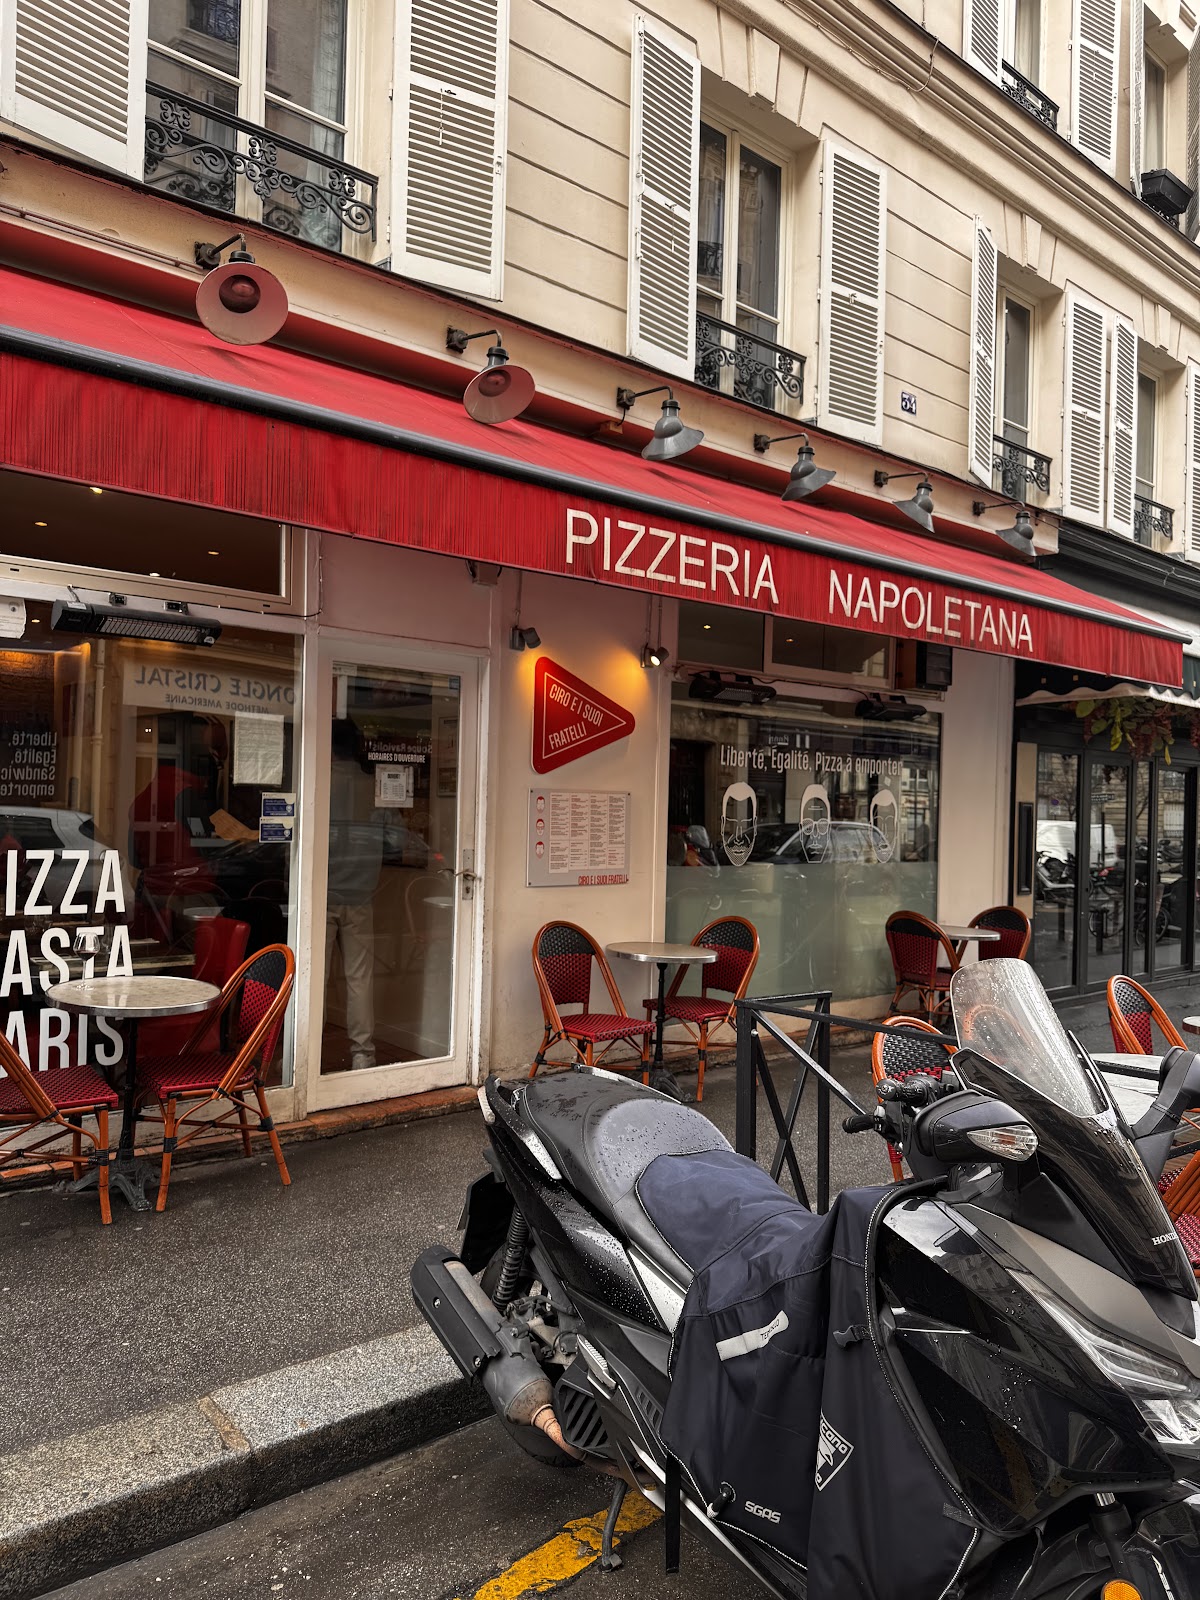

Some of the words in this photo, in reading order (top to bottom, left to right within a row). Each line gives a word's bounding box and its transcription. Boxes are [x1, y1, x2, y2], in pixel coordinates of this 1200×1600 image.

[565, 507, 779, 605] PIZZERIA
[828, 569, 1034, 653] NAPOLETANA
[549, 683, 571, 707] CIRO
[570, 696, 578, 712] E
[577, 700, 583, 715] I
[582, 703, 604, 727] SUOI
[548, 721, 587, 750] FRATELLI
[367, 752, 393, 762] HORAIRES
[720, 744, 768, 772] Liberté,
[771, 745, 812, 774] Égalité,
[815, 751, 843, 772] Pizza
[846, 753, 852, 773] à
[855, 757, 904, 778] emporter
[744, 1501, 781, 1524] SGAS
